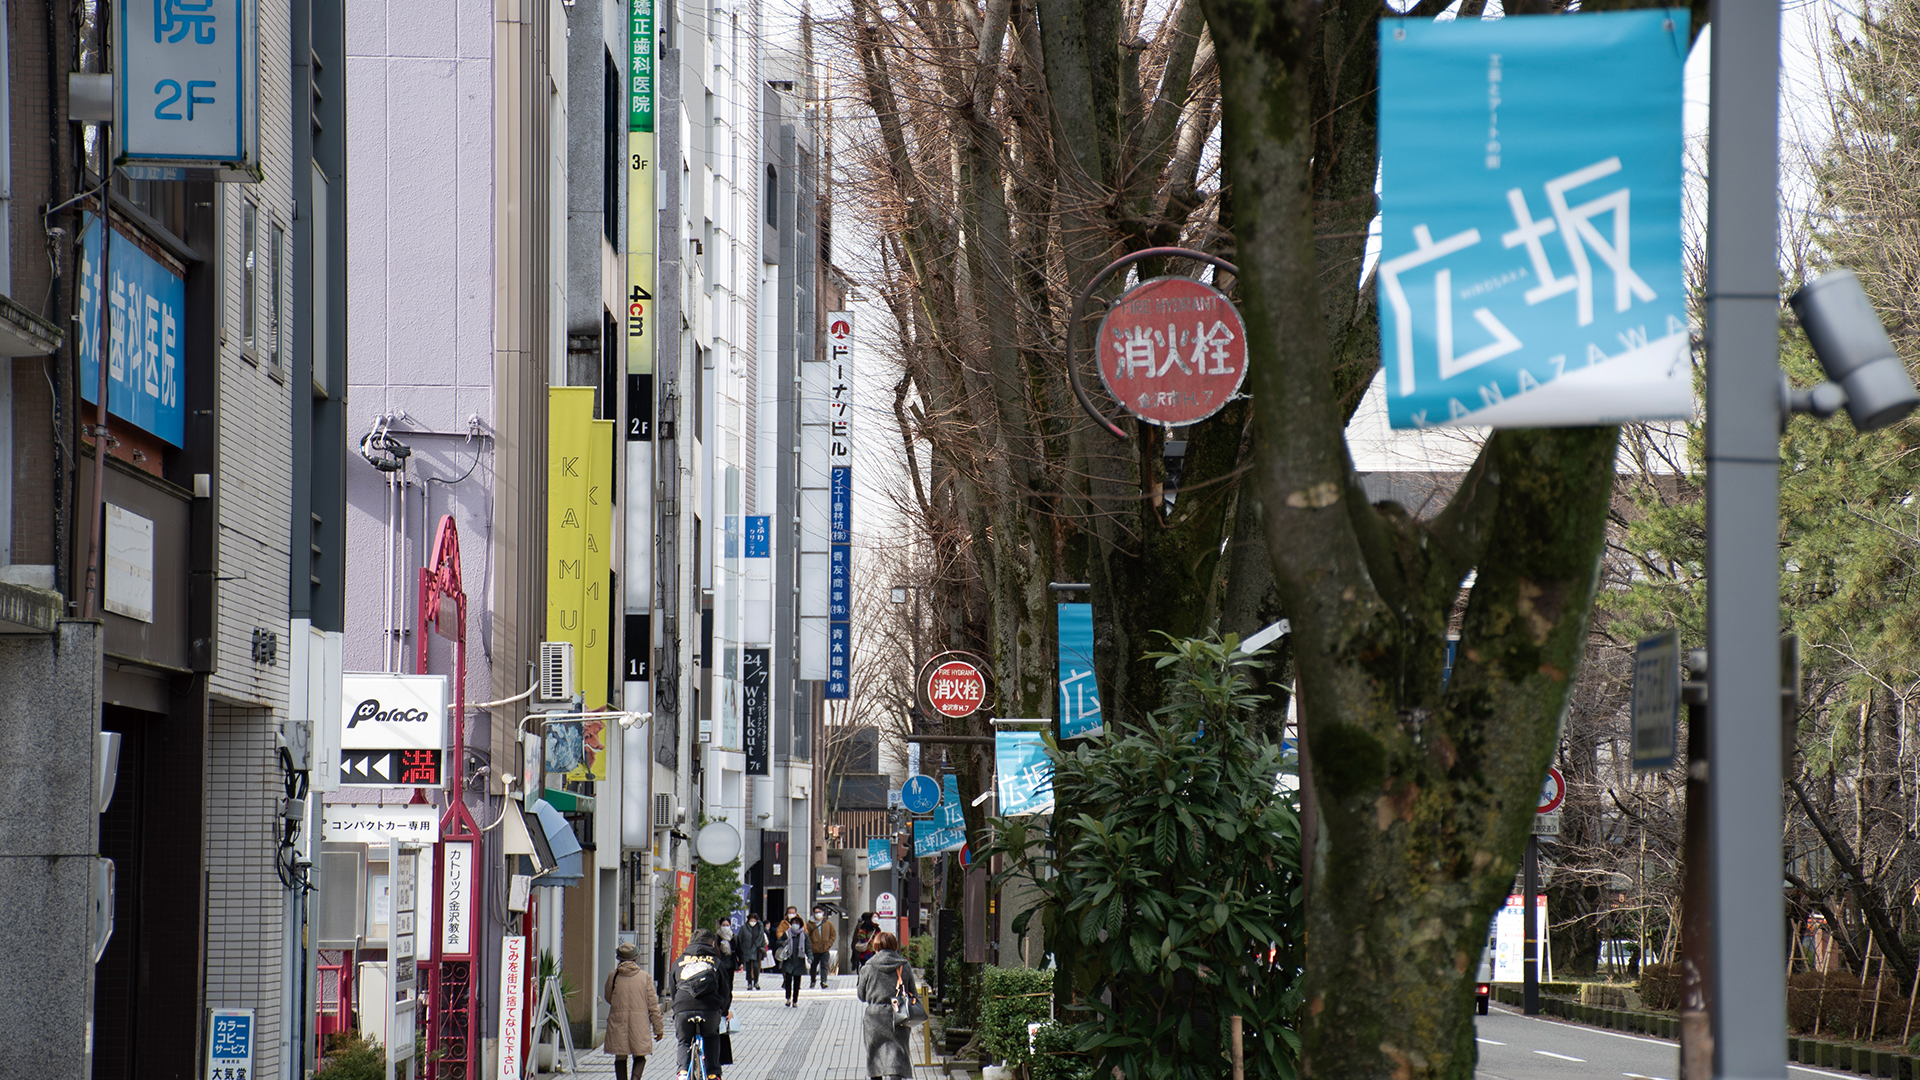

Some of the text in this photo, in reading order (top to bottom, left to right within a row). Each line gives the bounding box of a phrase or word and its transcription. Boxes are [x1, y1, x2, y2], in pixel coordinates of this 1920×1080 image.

[154, 0, 216, 45] 院
[632, 0, 651, 113] 矯正歯科医院
[154, 79, 216, 121] 2F
[632, 154, 649, 170] 3F
[1381, 156, 1658, 397] 広坂
[1460, 266, 1529, 299] HIROSAKA
[629, 285, 652, 337] 4cm
[1122, 295, 1218, 315] FIRE HYDRANT
[1112, 320, 1235, 379] 消火栓
[1411, 313, 1688, 427] KANAZAWA
[831, 345, 849, 456] ドーナツビル
[631, 418, 648, 436] 2F
[559, 456, 581, 631] KAMU
[629, 658, 646, 675] 1F
[744, 654, 768, 684] 24/7
[934, 679, 980, 700] 消火栓
[1060, 669, 1101, 725] 広
[346, 698, 429, 729] ParaCa
[744, 686, 760, 756] Workout
[402, 750, 435, 784] 満
[749, 760, 761, 771] 7F
[332, 820, 430, 831] コンパクトカー専用
[944, 801, 963, 826] 広
[868, 849, 888, 867] 広坂
[448, 849, 461, 945] カトリック金沢教会
[503, 939, 520, 1075] ごみを街に捨てないで下さい
[217, 1020, 246, 1032] カラー
[217, 1032, 246, 1044] コピー
[215, 1044, 246, 1054] サービス
[211, 1067, 247, 1080] 大気堂
